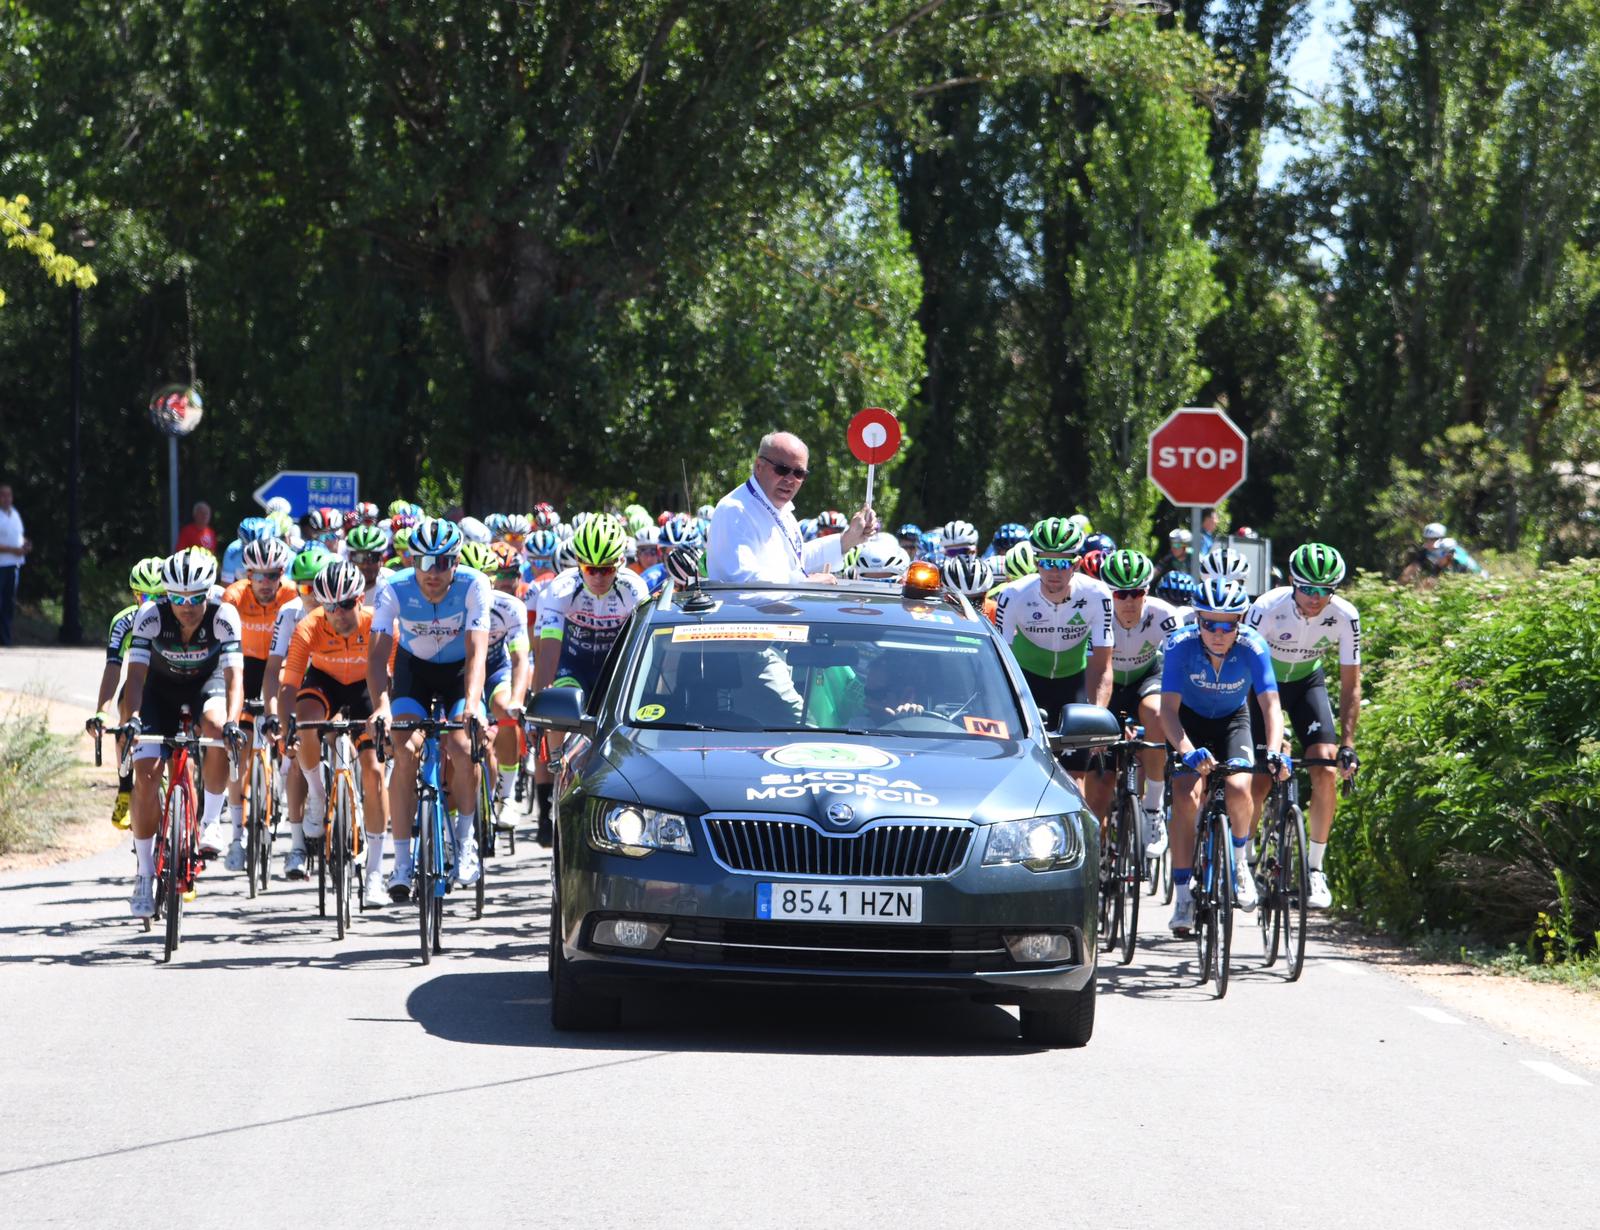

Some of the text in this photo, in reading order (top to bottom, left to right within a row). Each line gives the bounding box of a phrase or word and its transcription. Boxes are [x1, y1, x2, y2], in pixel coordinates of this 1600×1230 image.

[1158, 446, 1238, 470] STOP
[308, 492, 351, 505] Madrid
[138, 615, 159, 632] TREK
[215, 618, 235, 637] TREK
[161, 650, 208, 660] KOMETA
[972, 720, 1001, 734] M
[746, 782, 939, 807] MOTORCID
[761, 903, 767, 912] E
[782, 889, 912, 916] 8541 HZN
